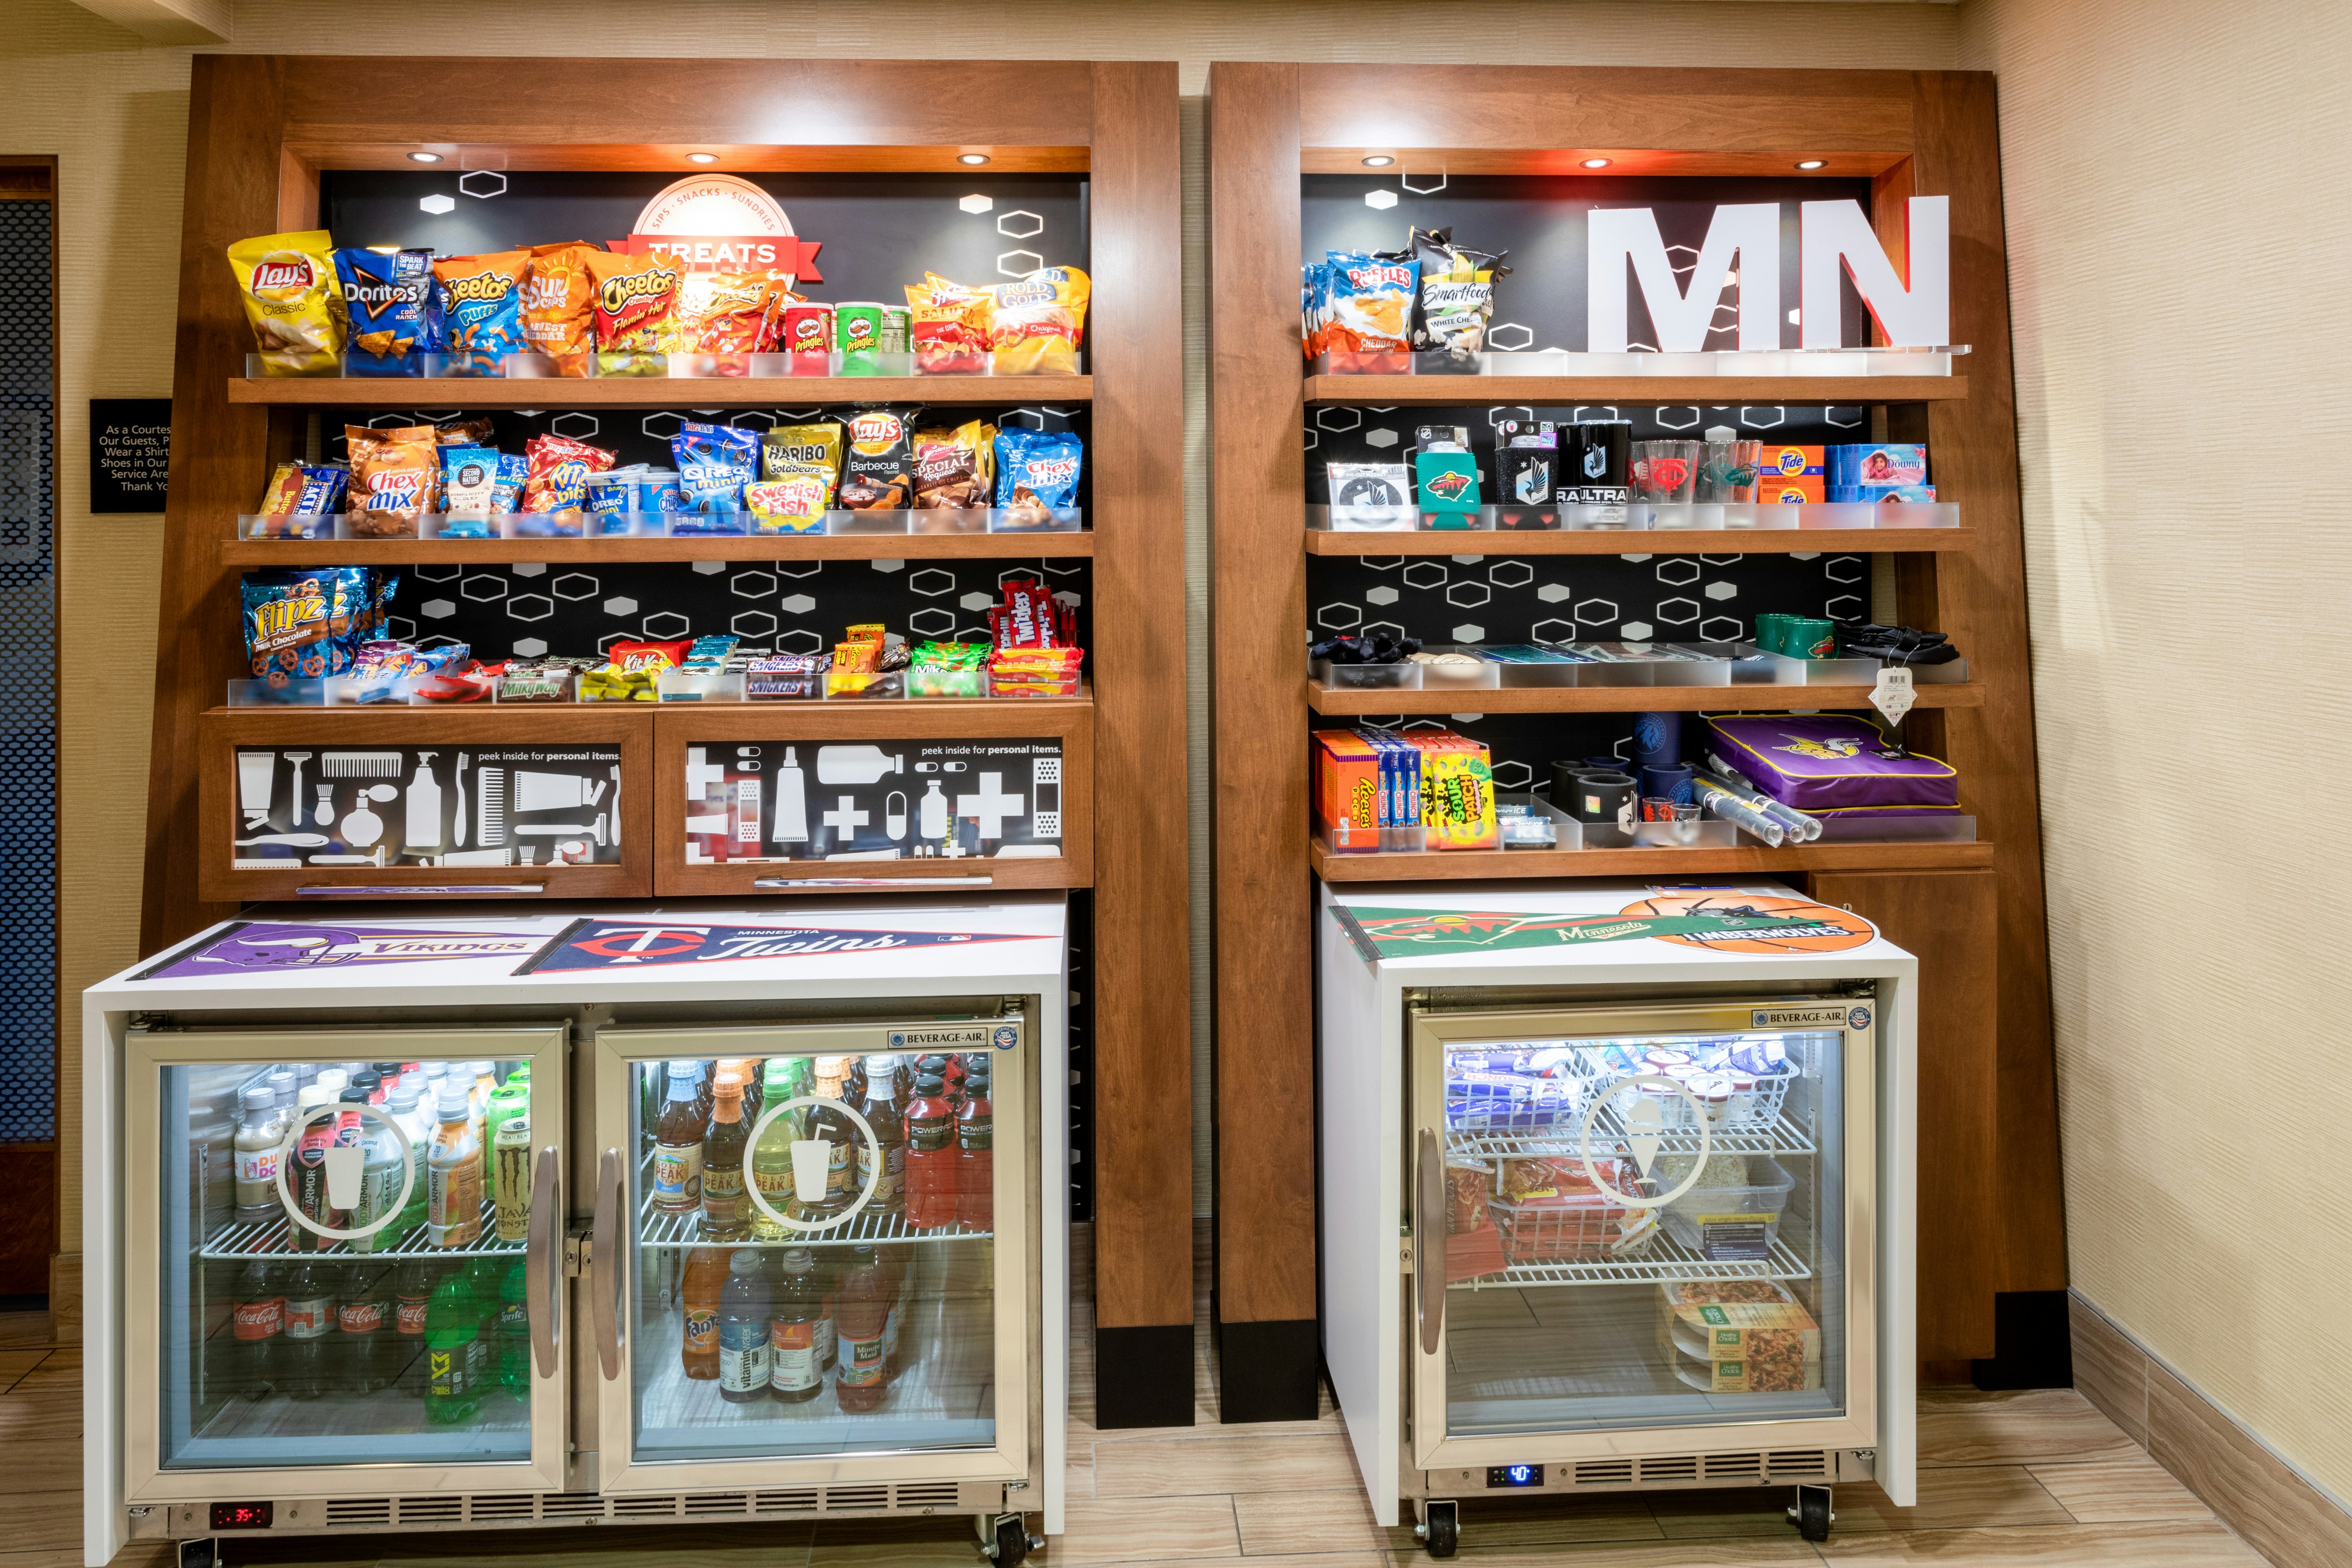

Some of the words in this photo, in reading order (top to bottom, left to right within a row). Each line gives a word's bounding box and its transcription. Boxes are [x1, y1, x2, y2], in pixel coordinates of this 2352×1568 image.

[652, 208, 670, 229] SIPS
[676, 188, 720, 205] SNACKS
[731, 192, 775, 230] SUNDRIES
[399, 254, 423, 264] SPARK
[649, 243, 776, 262] TREATS
[255, 262, 308, 290] Lay's
[1588, 195, 1949, 353] MN
[345, 284, 418, 302] Doritos
[603, 272, 676, 314] Cheetos
[1006, 283, 1049, 294] ROLD
[1423, 283, 1491, 307] Smartfood
[628, 295, 654, 306] Crunchy
[1001, 293, 1052, 308] GOLD
[263, 302, 306, 316] Classic
[649, 302, 666, 315] Hot
[1030, 325, 1062, 333] Original
[1431, 318, 1455, 328] WHITE
[795, 336, 824, 354] Pringles
[847, 336, 875, 354] Pringles
[1361, 338, 1397, 349] CHEDDAR
[106, 425, 119, 434] As
[131, 425, 171, 434] Courtes
[852, 419, 901, 443] Lay's
[99, 436, 120, 445] Our
[122, 436, 159, 446] Guests,
[105, 447, 133, 456] Wear
[145, 447, 170, 456] Shirt
[768, 445, 826, 463] HARIBO
[101, 458, 131, 467] Shoes
[134, 458, 144, 467] in
[147, 458, 167, 468] Our
[770, 464, 821, 474] Goldbears
[851, 462, 899, 471] Barbecue
[912, 456, 969, 478] SPECIAL
[1028, 457, 1074, 474] Chex
[1780, 455, 1804, 471] Tide
[1887, 459, 1920, 469] Downy
[111, 469, 147, 478] Service
[463, 468, 480, 477] SECOND
[683, 466, 745, 480] OREO
[924, 467, 956, 481] Request
[121, 481, 153, 491] Thank
[368, 472, 420, 492] Chex
[463, 476, 479, 485] NATURE
[697, 478, 736, 490] mini
[302, 486, 320, 507] ACT
[558, 487, 587, 503] bits
[751, 482, 825, 506] Swedish
[1532, 494, 1547, 503] MNUFC
[1581, 489, 1626, 501] ULTRA
[279, 490, 295, 515] Butter
[592, 499, 623, 512] OREO
[659, 496, 679, 512] Chips
[768, 499, 810, 516] Fish
[256, 597, 325, 643] Flipz
[1011, 592, 1035, 645] Twizzlers
[255, 642, 271, 652] Milk
[272, 629, 312, 646] Chocolate
[624, 654, 643, 671] Kit
[750, 661, 802, 671] SNICKERS
[750, 681, 799, 693] SNICKERS
[478, 752, 500, 762] peek
[503, 752, 528, 760] inside
[531, 752, 545, 760] for
[547, 752, 589, 762] personal
[592, 752, 621, 760] items.
[922, 746, 943, 756] peek
[988, 745, 1029, 755] personal
[1032, 745, 1061, 753] items.
[1359, 777, 1377, 829] Reese's
[1447, 778, 1464, 822] SOUR
[1460, 774, 1480, 823] PATCH
[1555, 921, 1651, 941] Minnesota
[697, 933, 907, 961] Twins
[1771, 1012, 1841, 1022] BEVERAGE-AIR
[907, 1033, 982, 1043] BEVERAGE-AIR
[656, 1160, 684, 1169] GOLD
[656, 1168, 685, 1180] PEAK
[706, 1178, 735, 1190] PEAK
[756, 1179, 786, 1192] PEAK
[238, 1304, 281, 1325] Coca-Cola
[340, 1301, 385, 1323] Coca-Cola
[501, 1310, 523, 1324] Sprite
[685, 1315, 720, 1336] Fanta
[857, 1343, 880, 1353] Minute
[860, 1350, 878, 1359] Maid
[742, 1327, 752, 1389] vitaminwater
